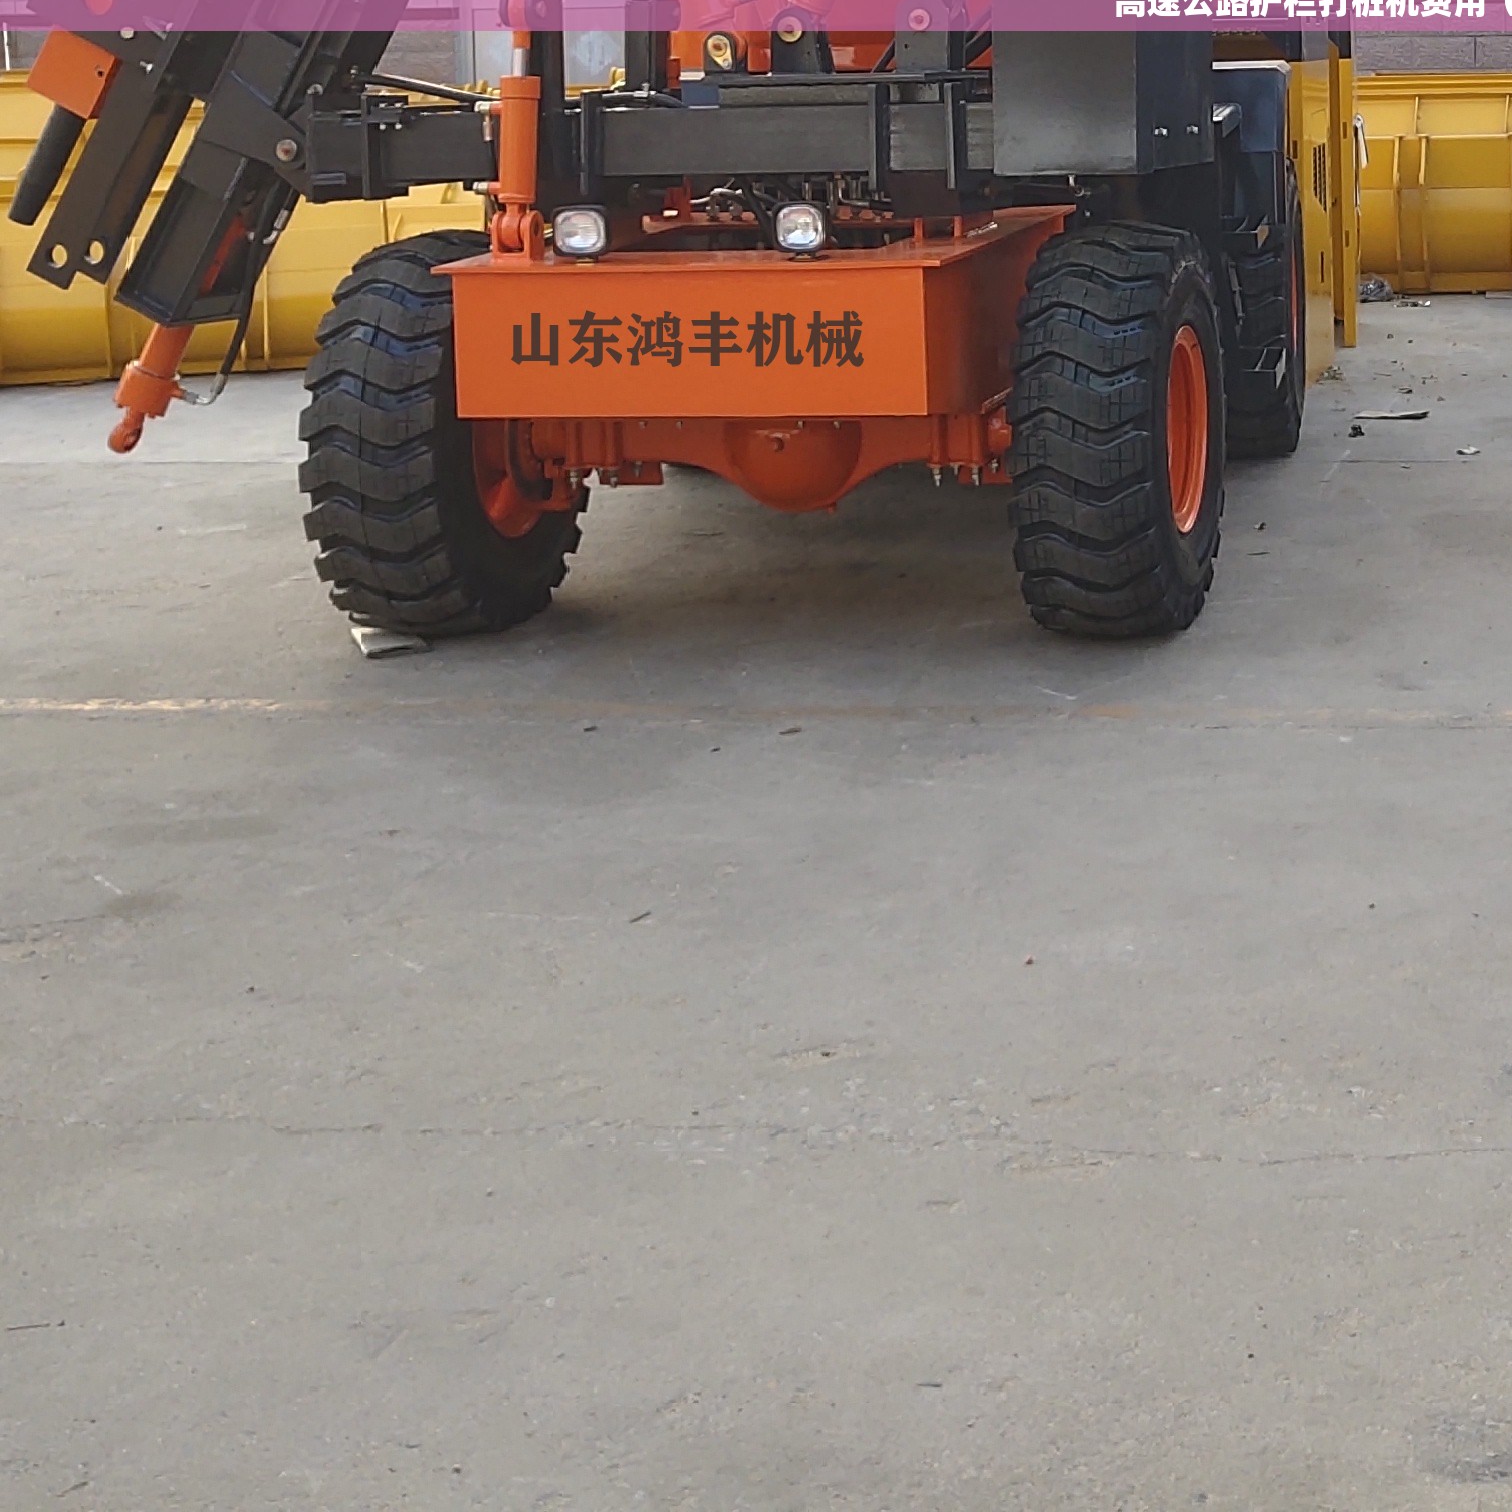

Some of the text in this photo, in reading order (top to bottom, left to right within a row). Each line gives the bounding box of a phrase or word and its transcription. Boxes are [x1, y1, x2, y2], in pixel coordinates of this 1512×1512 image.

[510, 310, 864, 368] 山东鸿丰机械
